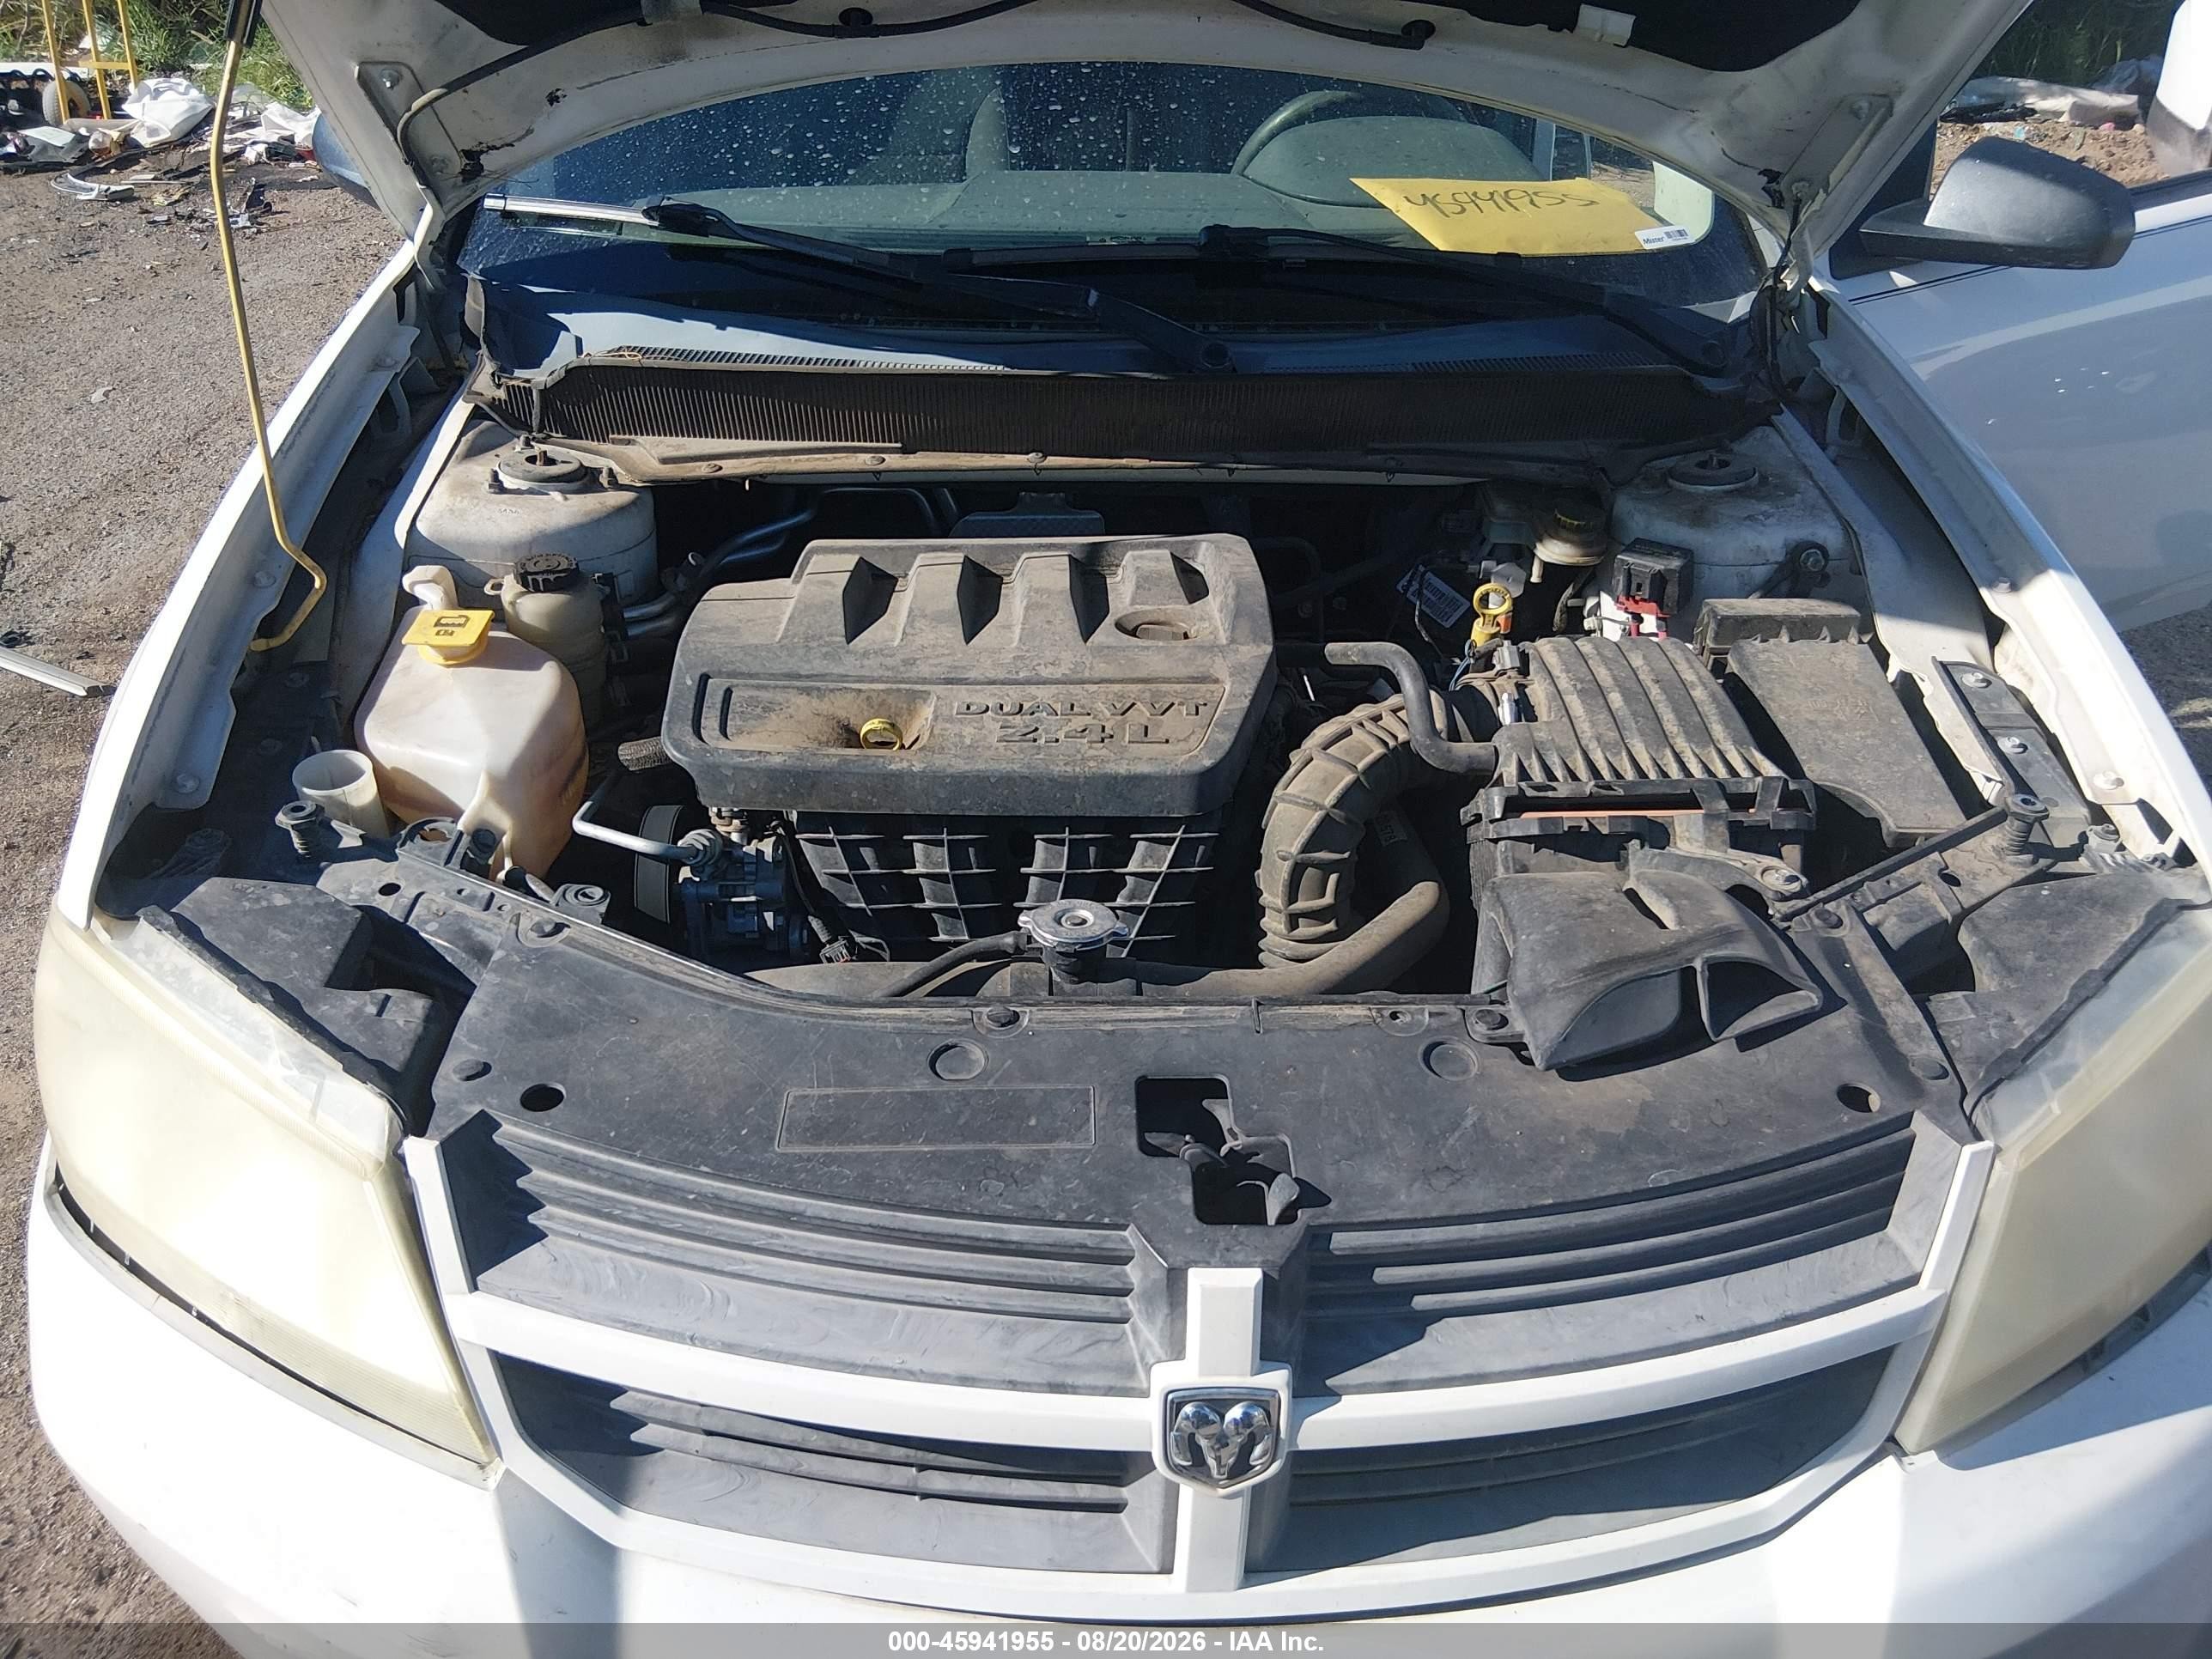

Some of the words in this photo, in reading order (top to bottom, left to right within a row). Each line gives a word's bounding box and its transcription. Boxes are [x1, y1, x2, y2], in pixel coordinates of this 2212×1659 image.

[955, 700, 1091, 717] DUAL
[1099, 700, 1208, 717] VVT
[996, 723, 1170, 745] 2.4L
